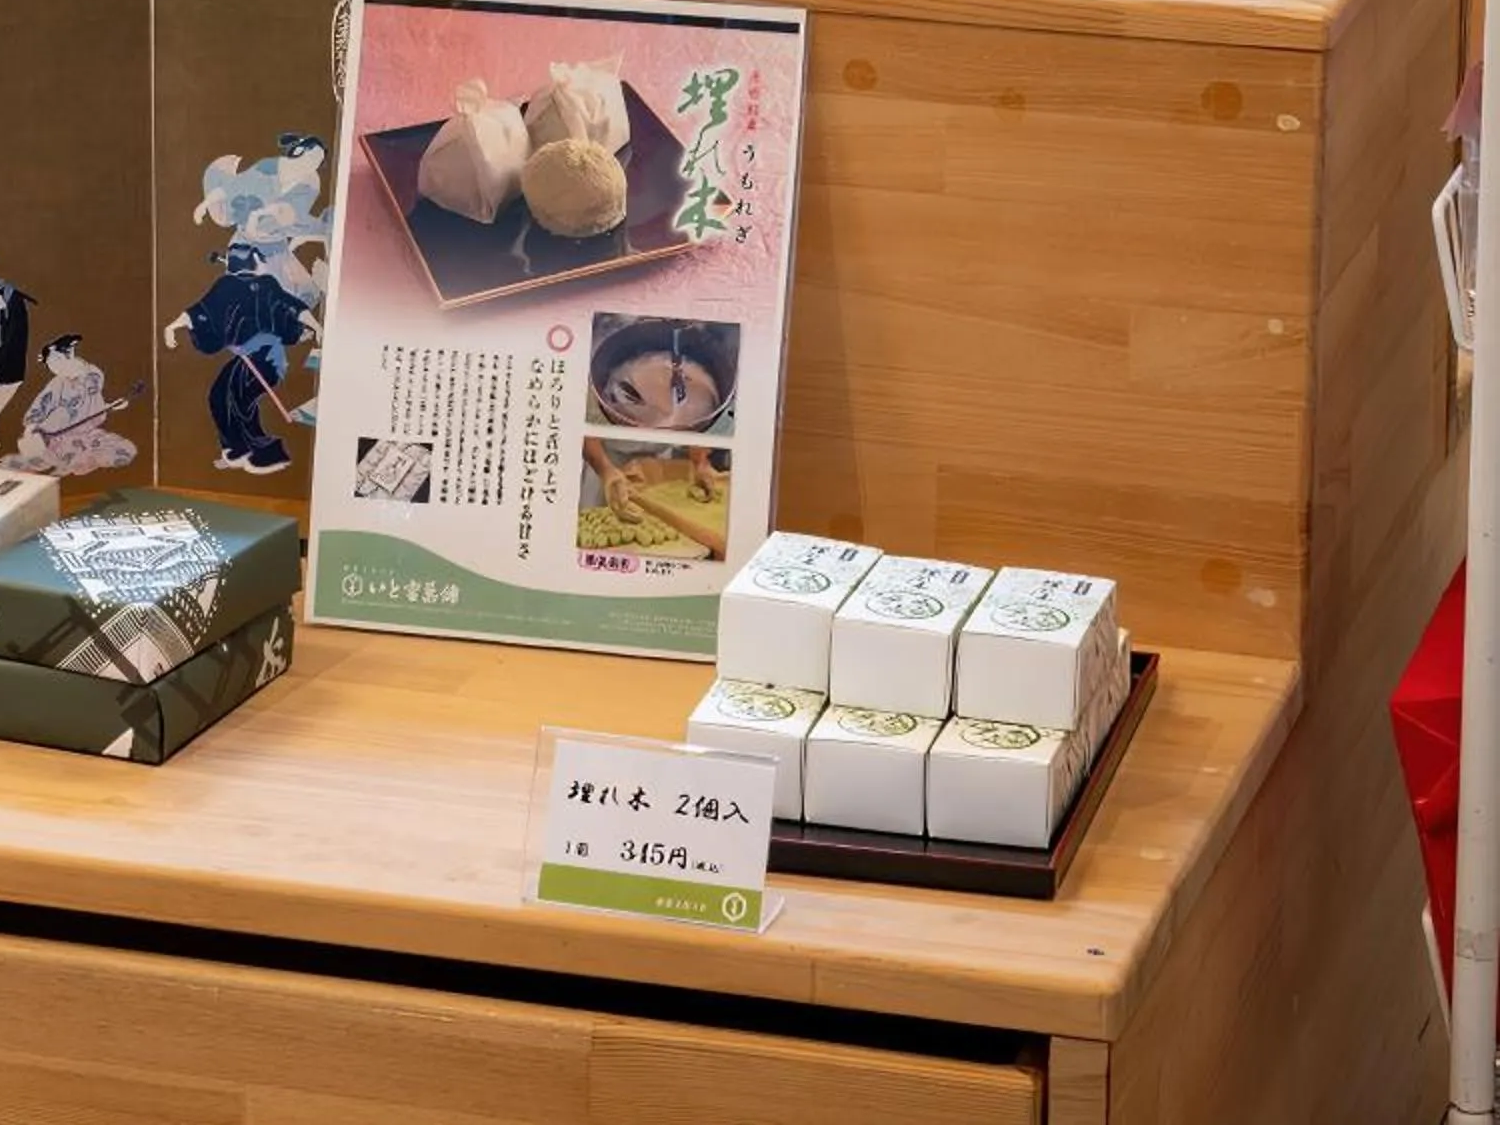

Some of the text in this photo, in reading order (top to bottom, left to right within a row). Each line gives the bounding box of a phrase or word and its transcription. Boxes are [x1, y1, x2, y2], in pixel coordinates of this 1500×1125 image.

[733, 144, 756, 245] うもれぎ
[675, 793, 750, 824] 2個入
